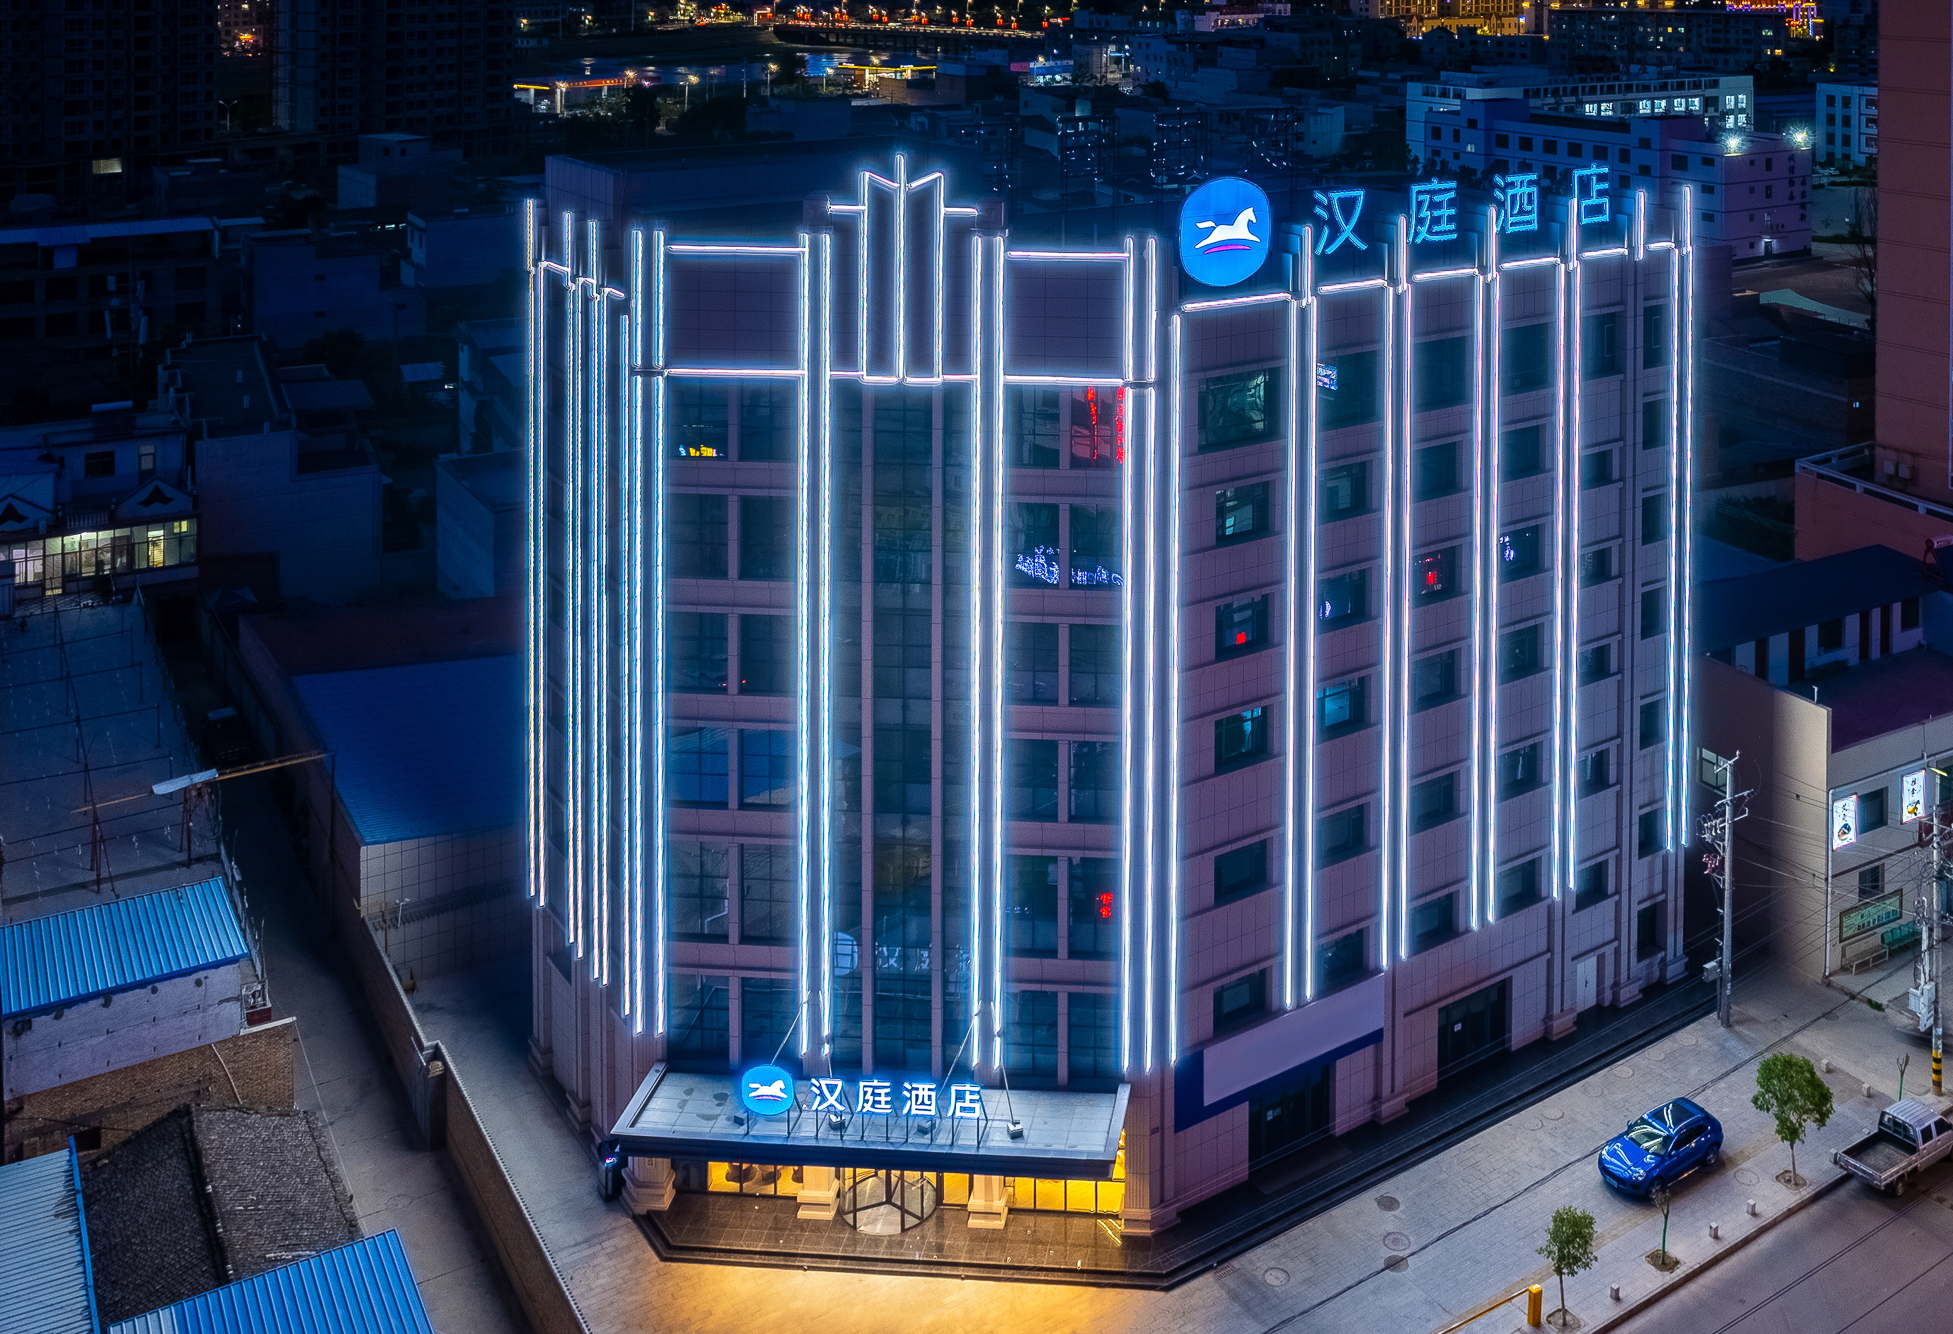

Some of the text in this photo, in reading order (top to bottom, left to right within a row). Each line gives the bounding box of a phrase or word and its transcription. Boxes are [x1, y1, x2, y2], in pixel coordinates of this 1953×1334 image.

[1313, 163, 1609, 255] 汉庭酒店
[810, 1078, 981, 1118] 汉庭酒店
